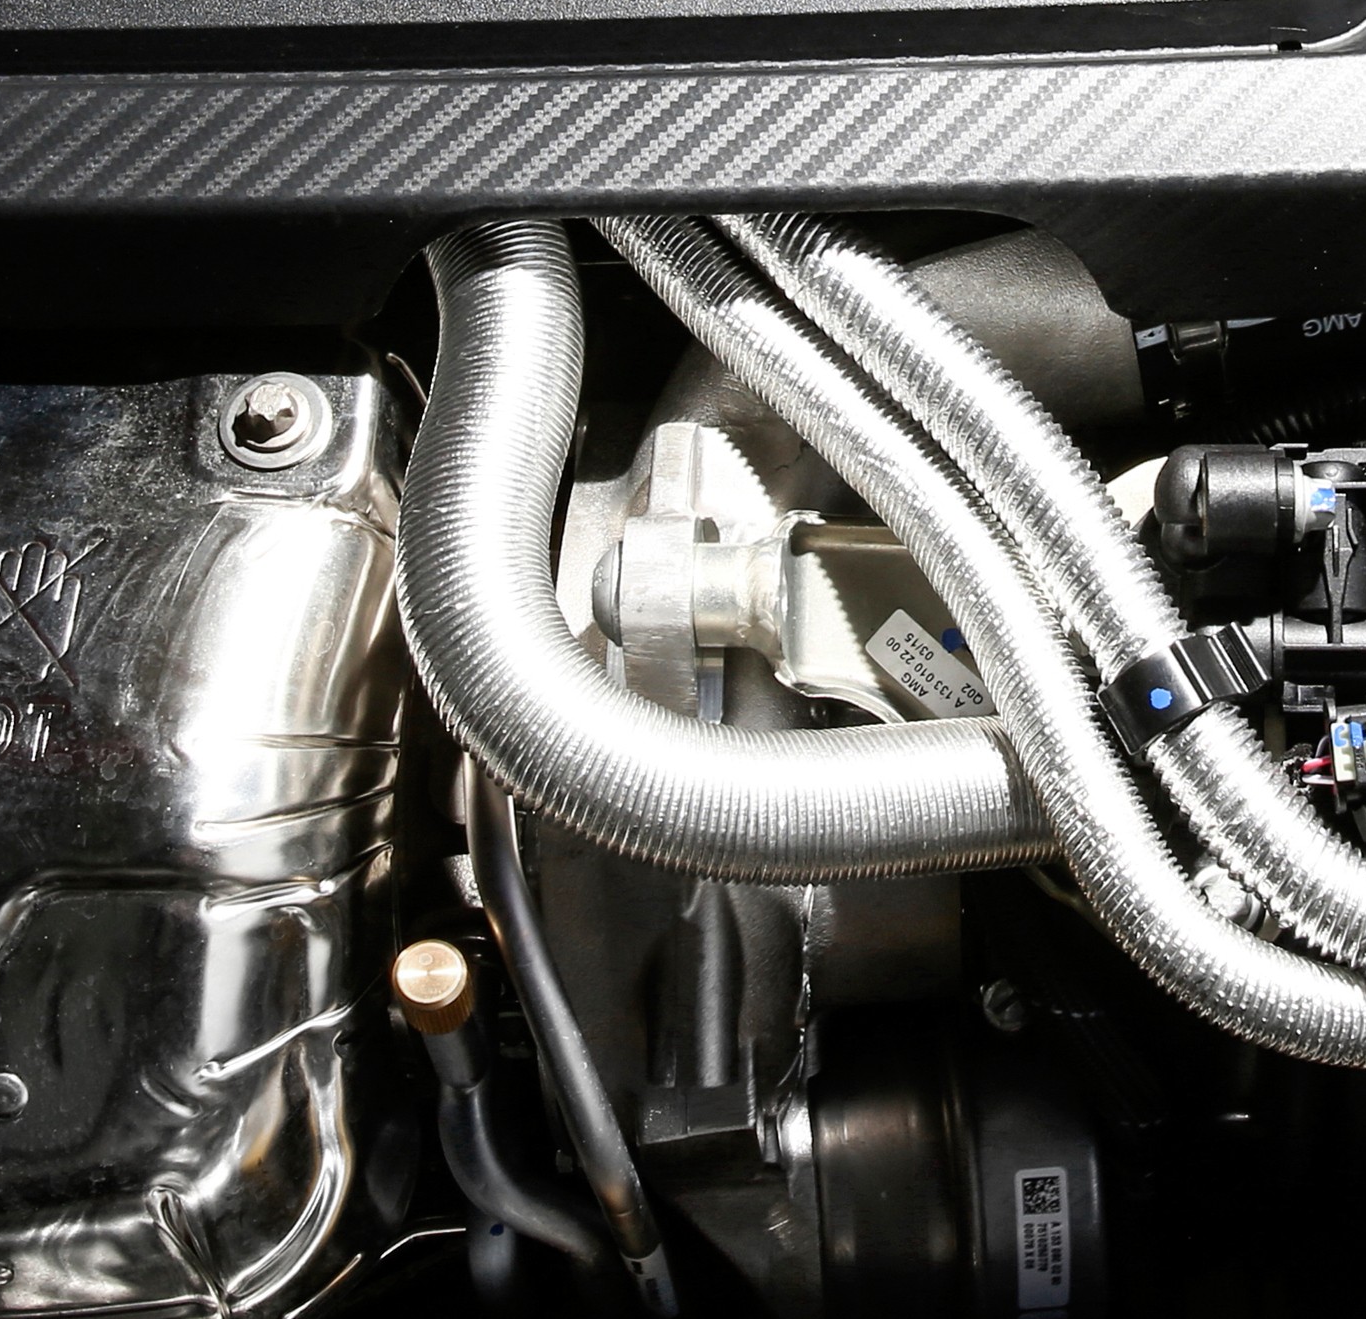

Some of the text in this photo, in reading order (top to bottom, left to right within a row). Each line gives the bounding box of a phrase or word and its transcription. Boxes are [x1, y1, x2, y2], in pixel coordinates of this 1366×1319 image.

[1302, 312, 1363, 337] AMG
[886, 637, 966, 708] A 133 010 22 00
[900, 672, 929, 697] AMG
[904, 633, 984, 705] Q02 03/15
